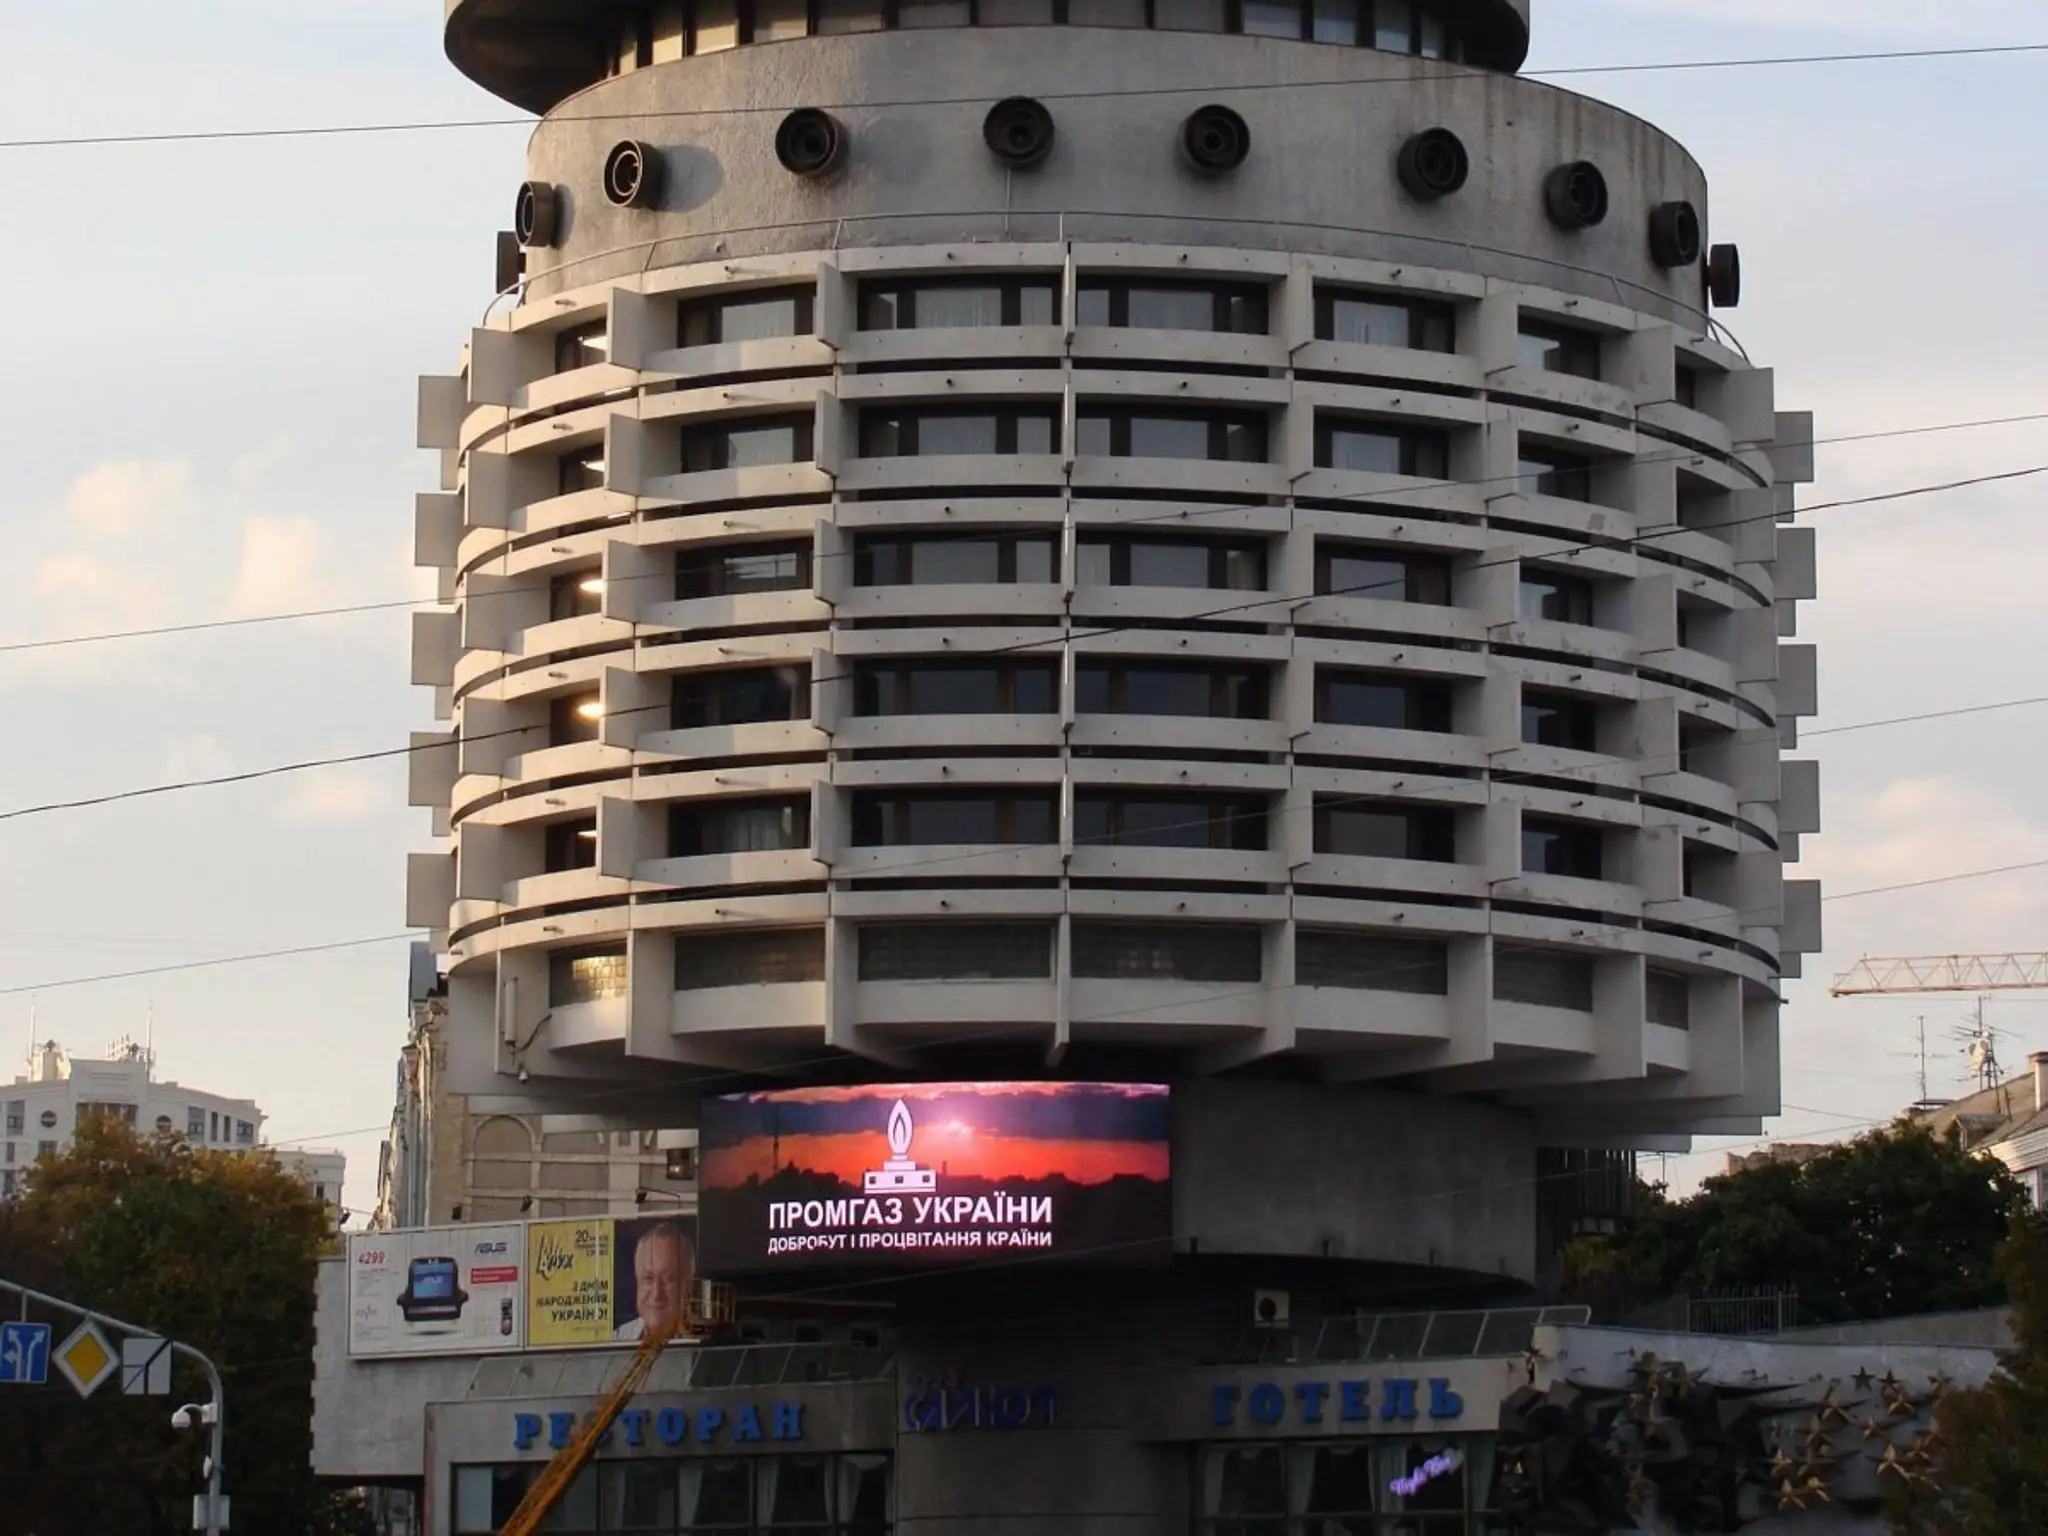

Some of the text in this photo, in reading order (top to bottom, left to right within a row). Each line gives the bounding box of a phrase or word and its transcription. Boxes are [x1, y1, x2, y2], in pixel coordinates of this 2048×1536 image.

[769, 1191, 1052, 1229] ПРОМГАЗ УКРАЇНИ
[474, 1242, 508, 1254] ASUS
[767, 1228, 1052, 1255] ДОБРОБУТ І ПРОЦВІТАННЯ КРАЇНИ
[357, 1251, 386, 1265] 4299
[580, 1279, 609, 1291] ДНМ
[1212, 1377, 1465, 1426] ГОТЕЛЬ
